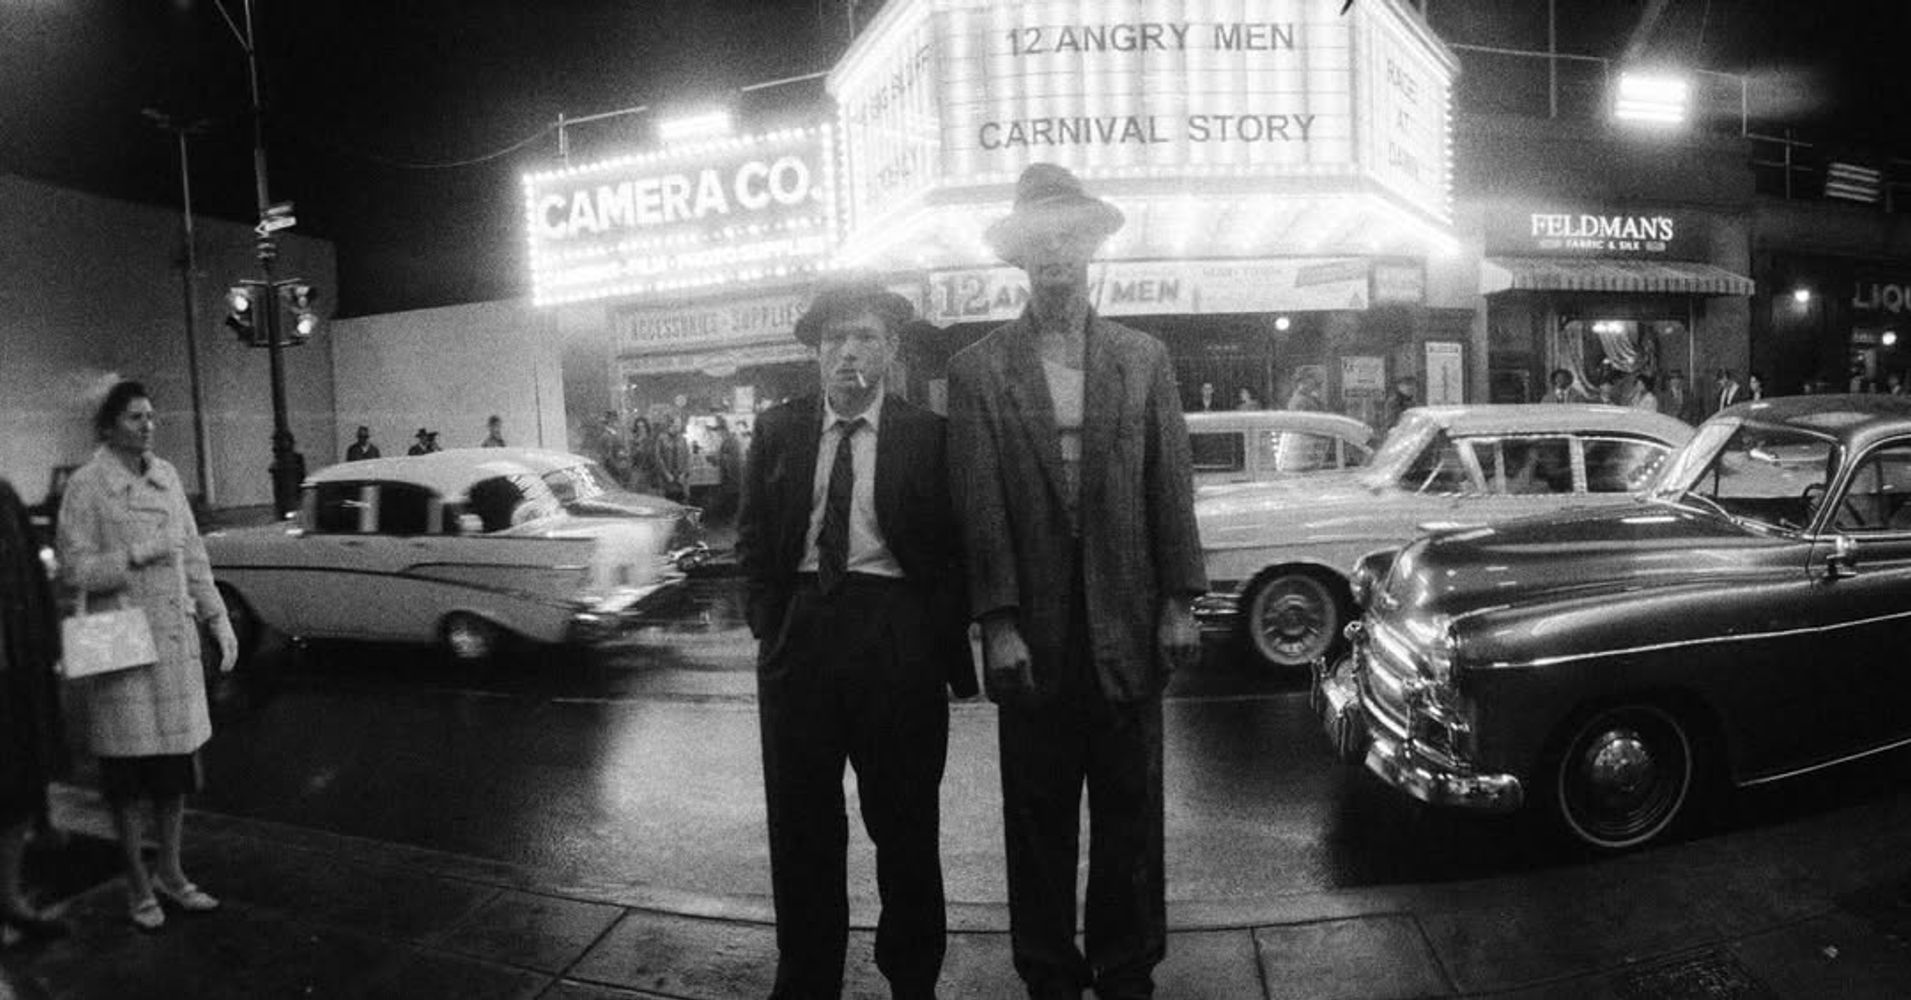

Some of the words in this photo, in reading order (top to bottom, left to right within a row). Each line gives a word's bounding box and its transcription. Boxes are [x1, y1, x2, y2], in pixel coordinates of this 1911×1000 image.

[1005, 27, 1043, 57] 12
[1055, 22, 1190, 53] ANGRY
[1213, 23, 1294, 51] MEN
[978, 115, 1170, 151] CARNIVAL
[1187, 114, 1316, 143] STORY
[542, 168, 731, 239] CAMERA
[734, 155, 823, 210] CO.
[1531, 213, 1674, 241] FELDMAN'S
[1565, 239, 1604, 249] FABRIC
[1608, 240, 1617, 250] &
[1619, 240, 1640, 251] SILK
[939, 273, 990, 319] 12
[1110, 278, 1180, 305] MEN
